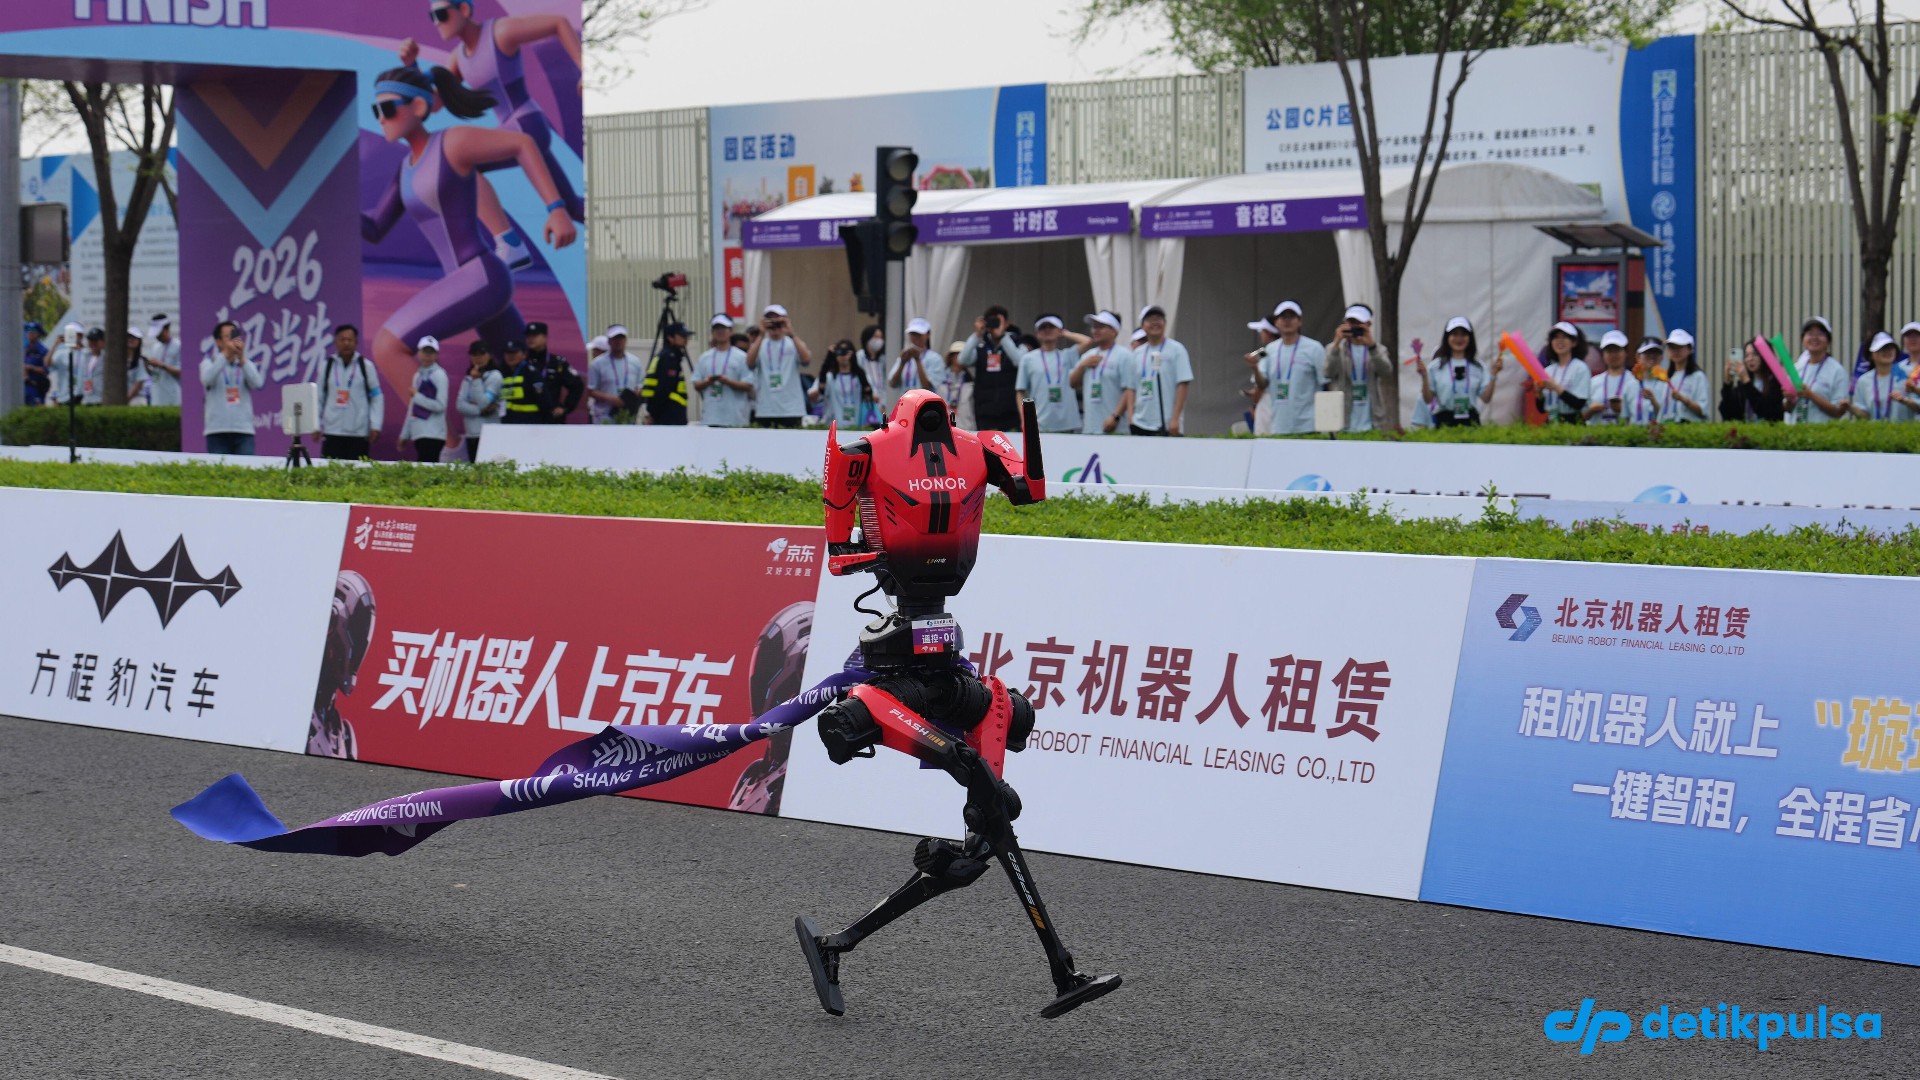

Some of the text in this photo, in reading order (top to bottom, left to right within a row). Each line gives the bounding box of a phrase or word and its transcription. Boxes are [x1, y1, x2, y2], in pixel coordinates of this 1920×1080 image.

[724, 134, 796, 161] 园区活动
[230, 230, 322, 310] 2026
[201, 301, 334, 388] 马当先
[823, 447, 832, 490] HONOR
[908, 477, 967, 491] HONOR
[765, 566, 812, 577] 又好又便宜
[785, 544, 816, 563] 京东
[1554, 597, 1751, 639] 北京机器人租赁
[1552, 633, 1584, 645] BEIJING
[1588, 637, 1618, 647] ROBOT
[1621, 638, 1664, 650] FINANCIAL
[1668, 644, 1706, 653] LEASING
[30, 648, 220, 718] 方程豹汽车
[371, 628, 736, 734] 买机器人上京东
[969, 632, 1392, 742] 北京机器人租赁
[889, 708, 929, 736] FLASH
[572, 769, 634, 789] SHANG
[638, 752, 694, 779] E-TOWN
[1029, 729, 1091, 755] ROBOT
[1100, 736, 1193, 766] FINANCIAL
[1203, 746, 1286, 775] LEASING
[1007, 851, 1036, 906] SPEED
